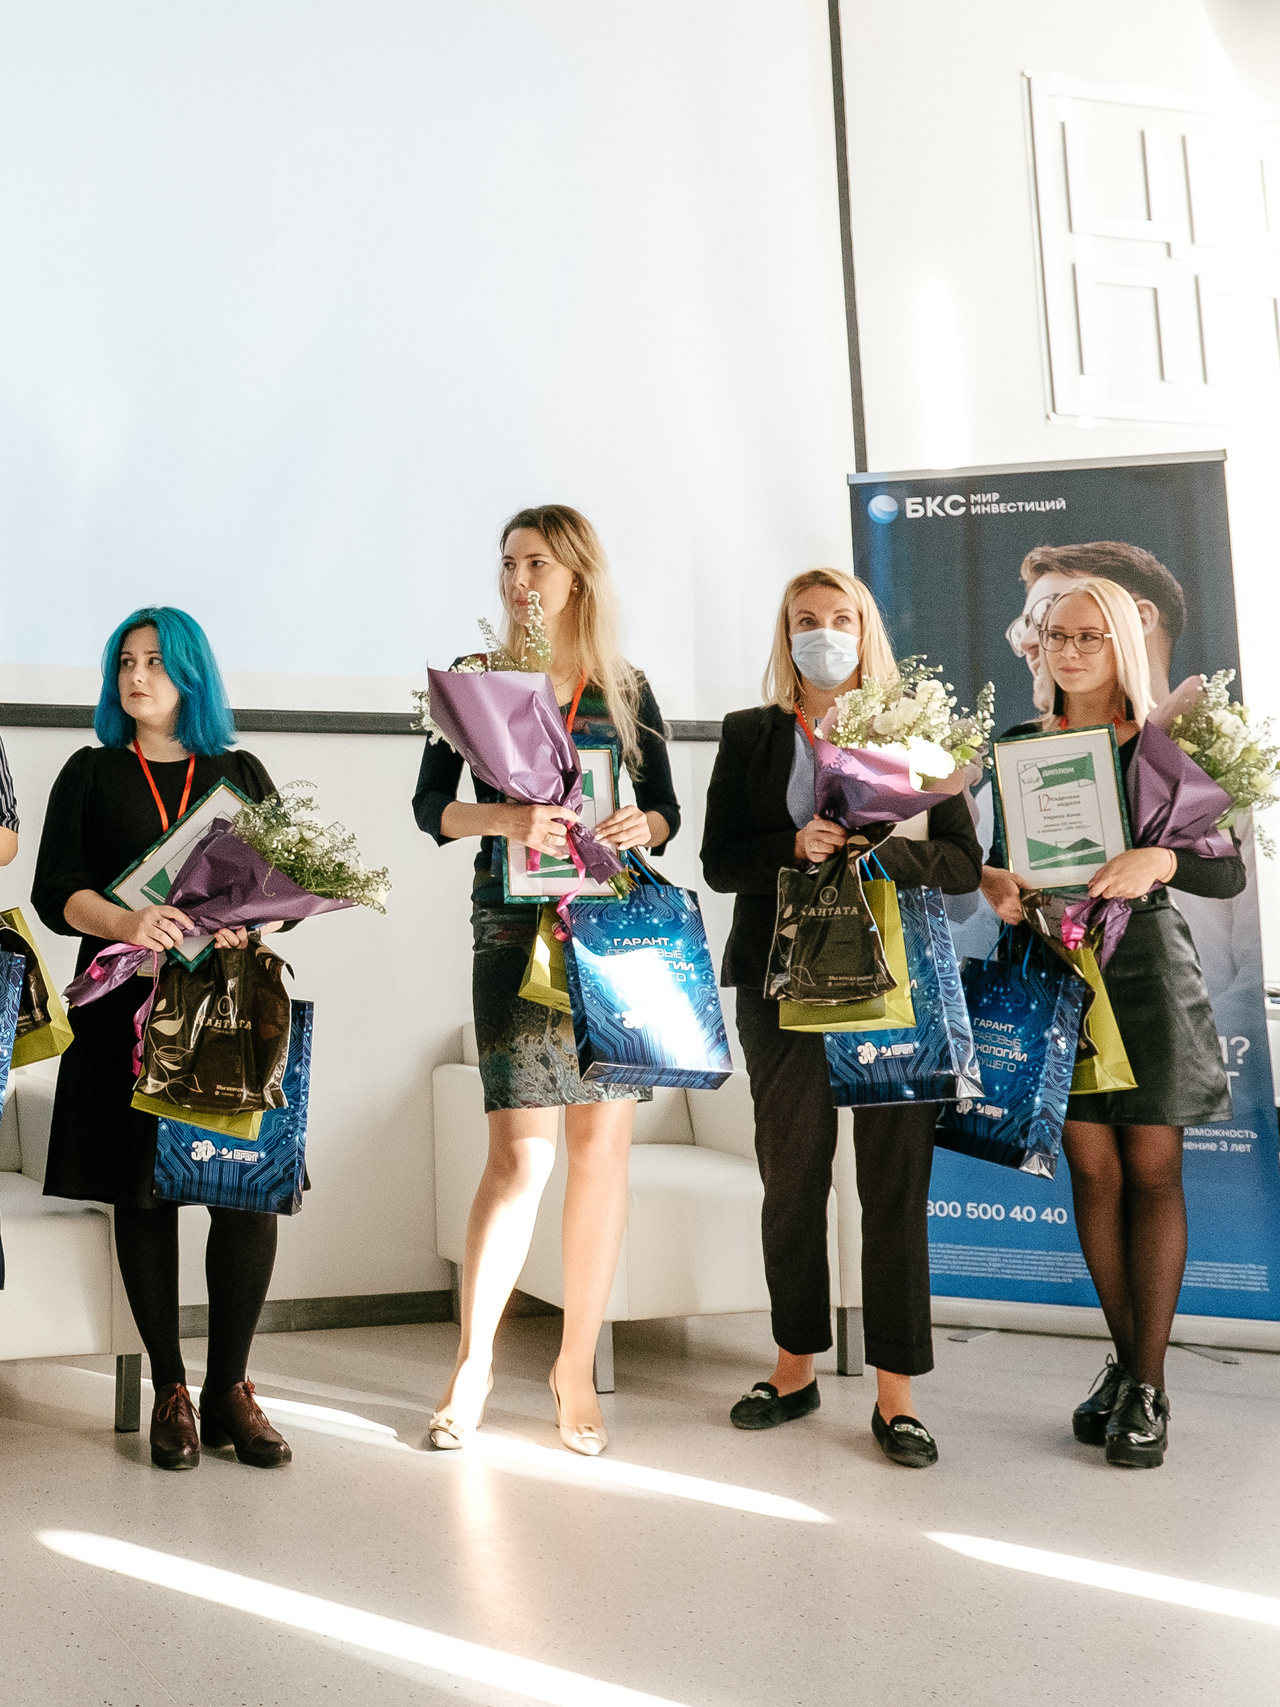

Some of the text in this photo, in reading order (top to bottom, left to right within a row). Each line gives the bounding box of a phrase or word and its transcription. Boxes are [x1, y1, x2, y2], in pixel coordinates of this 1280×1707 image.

[905, 494, 967, 519] БКС
[970, 492, 1000, 504] МИР
[970, 497, 1067, 515] ИНВЕСТИЦИЙ
[1037, 793, 1052, 812] 12
[613, 936, 673, 947] ГАРАНТ.
[198, 1018, 252, 1030] АНТАТА
[973, 1017, 1016, 1035] ГАРАНТ.
[972, 1029, 1022, 1048] РАВОВЫЕ
[1183, 1127, 1258, 1139] озможность
[1220, 1141, 1229, 1152] 3
[1229, 1143, 1252, 1153] лет
[966, 1202, 1006, 1221] 500
[1009, 1205, 1037, 1223] 40
[1040, 1207, 1068, 1225] 40
